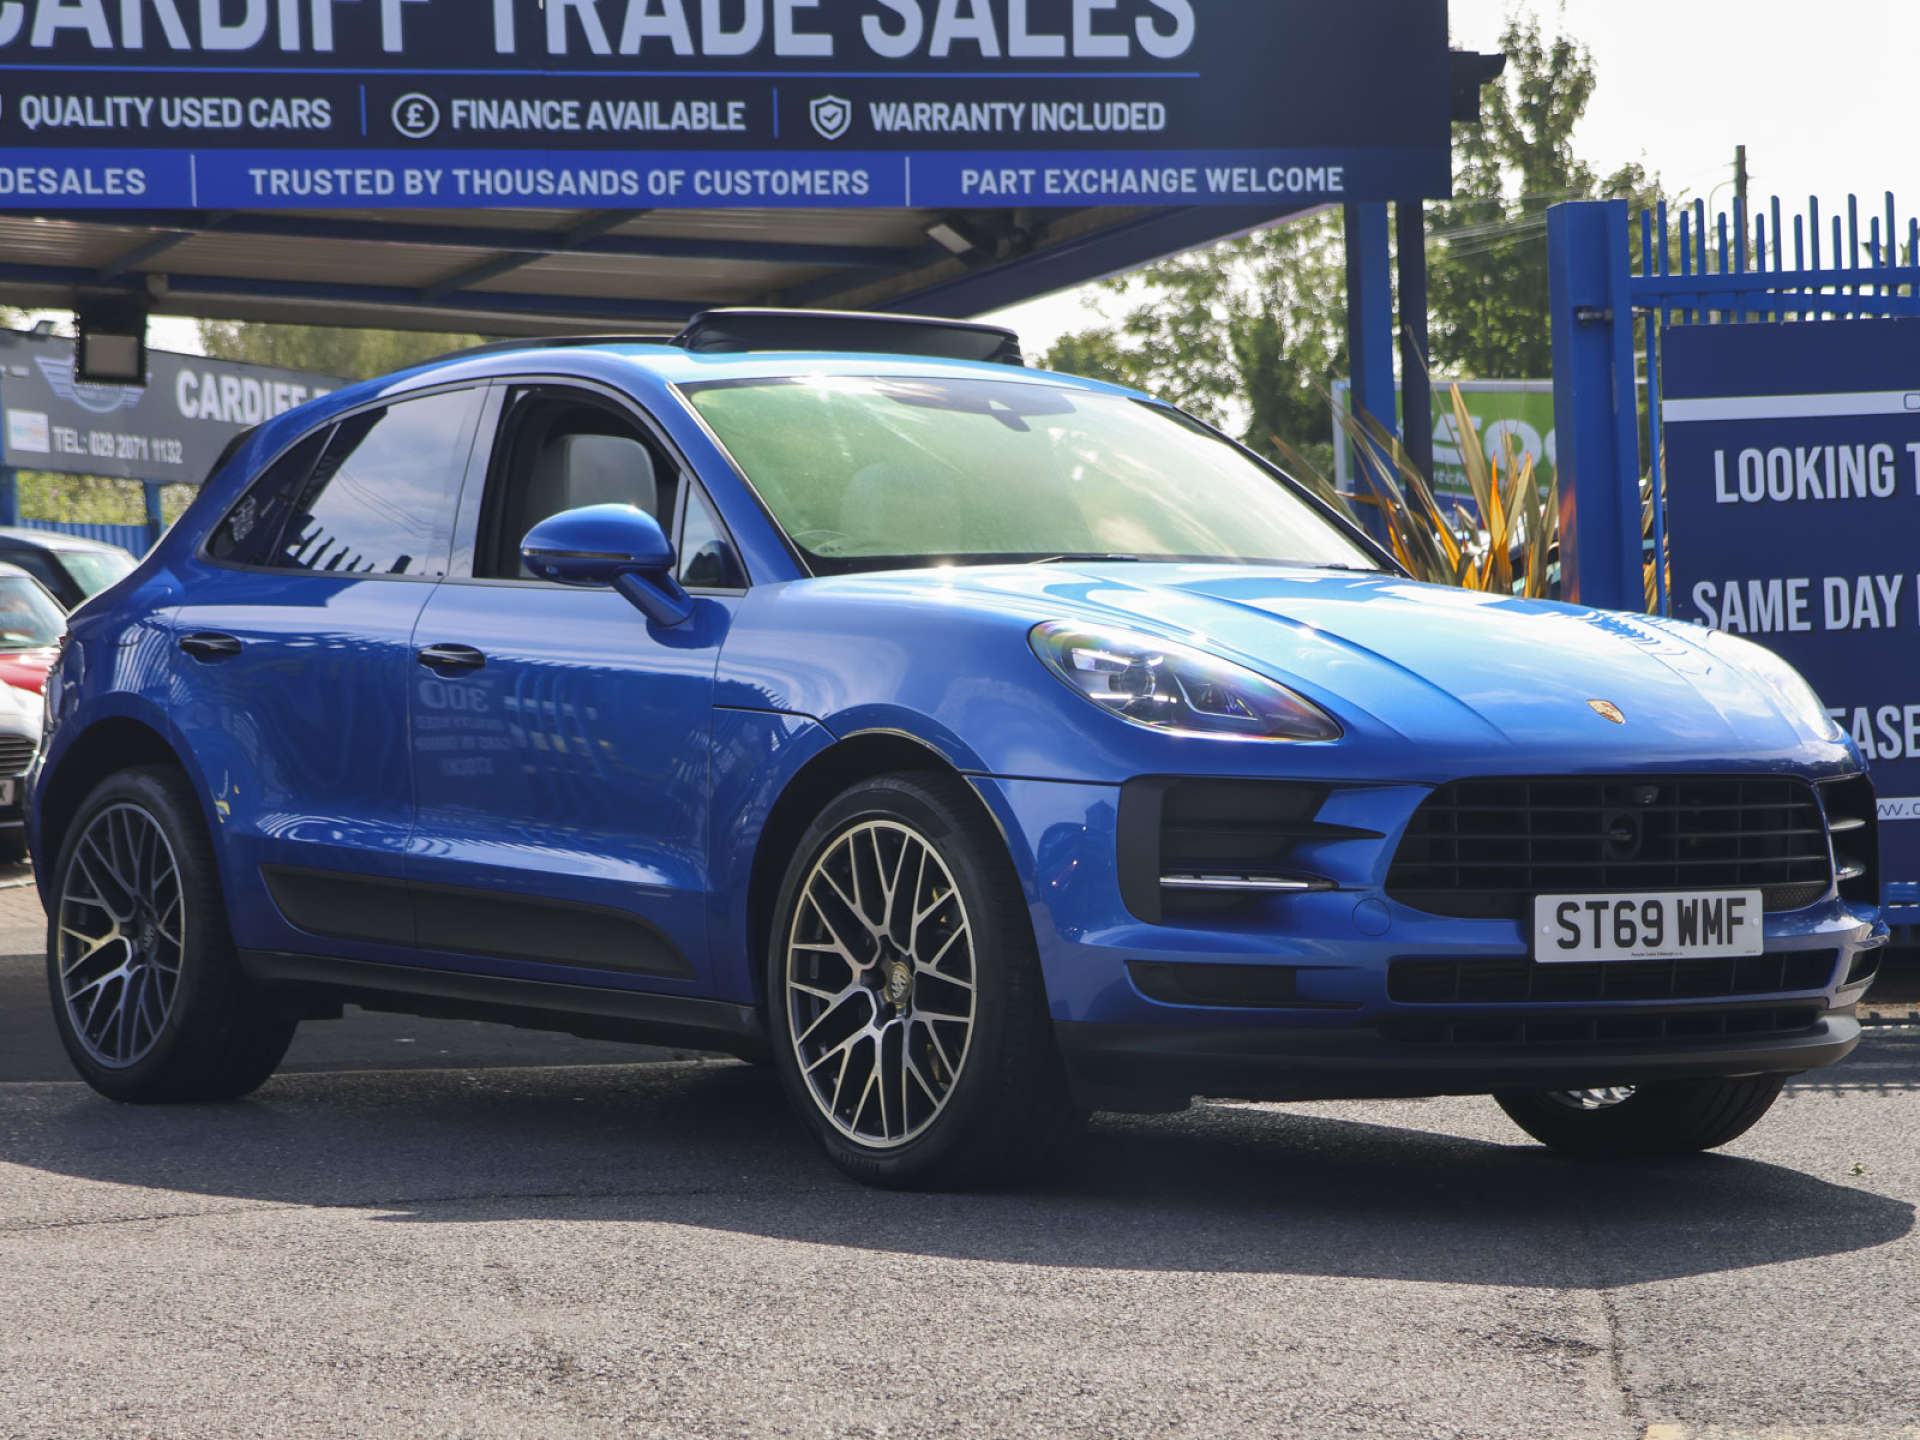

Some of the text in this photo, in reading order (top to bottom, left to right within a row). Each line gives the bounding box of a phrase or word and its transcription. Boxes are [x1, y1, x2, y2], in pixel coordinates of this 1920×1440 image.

[0, 0, 429, 52] ARDI
[20, 95, 332, 130] QUALITY USED CARS
[451, 99, 581, 130] FINANCE
[586, 101, 747, 131] AVAILABLE
[869, 102, 1166, 132] WARRANTY INCLUDED
[249, 168, 870, 196] TRUSTED BY THOUSANDS OF CUSTOMERS
[961, 166, 1345, 195] PART EXCHANGE WELCOME
[1714, 443, 1896, 503] LOOKING
[1692, 574, 1904, 634] SAME DAY
[1826, 704, 1920, 760] ASE
[1556, 897, 1747, 950] ST69 WMF
